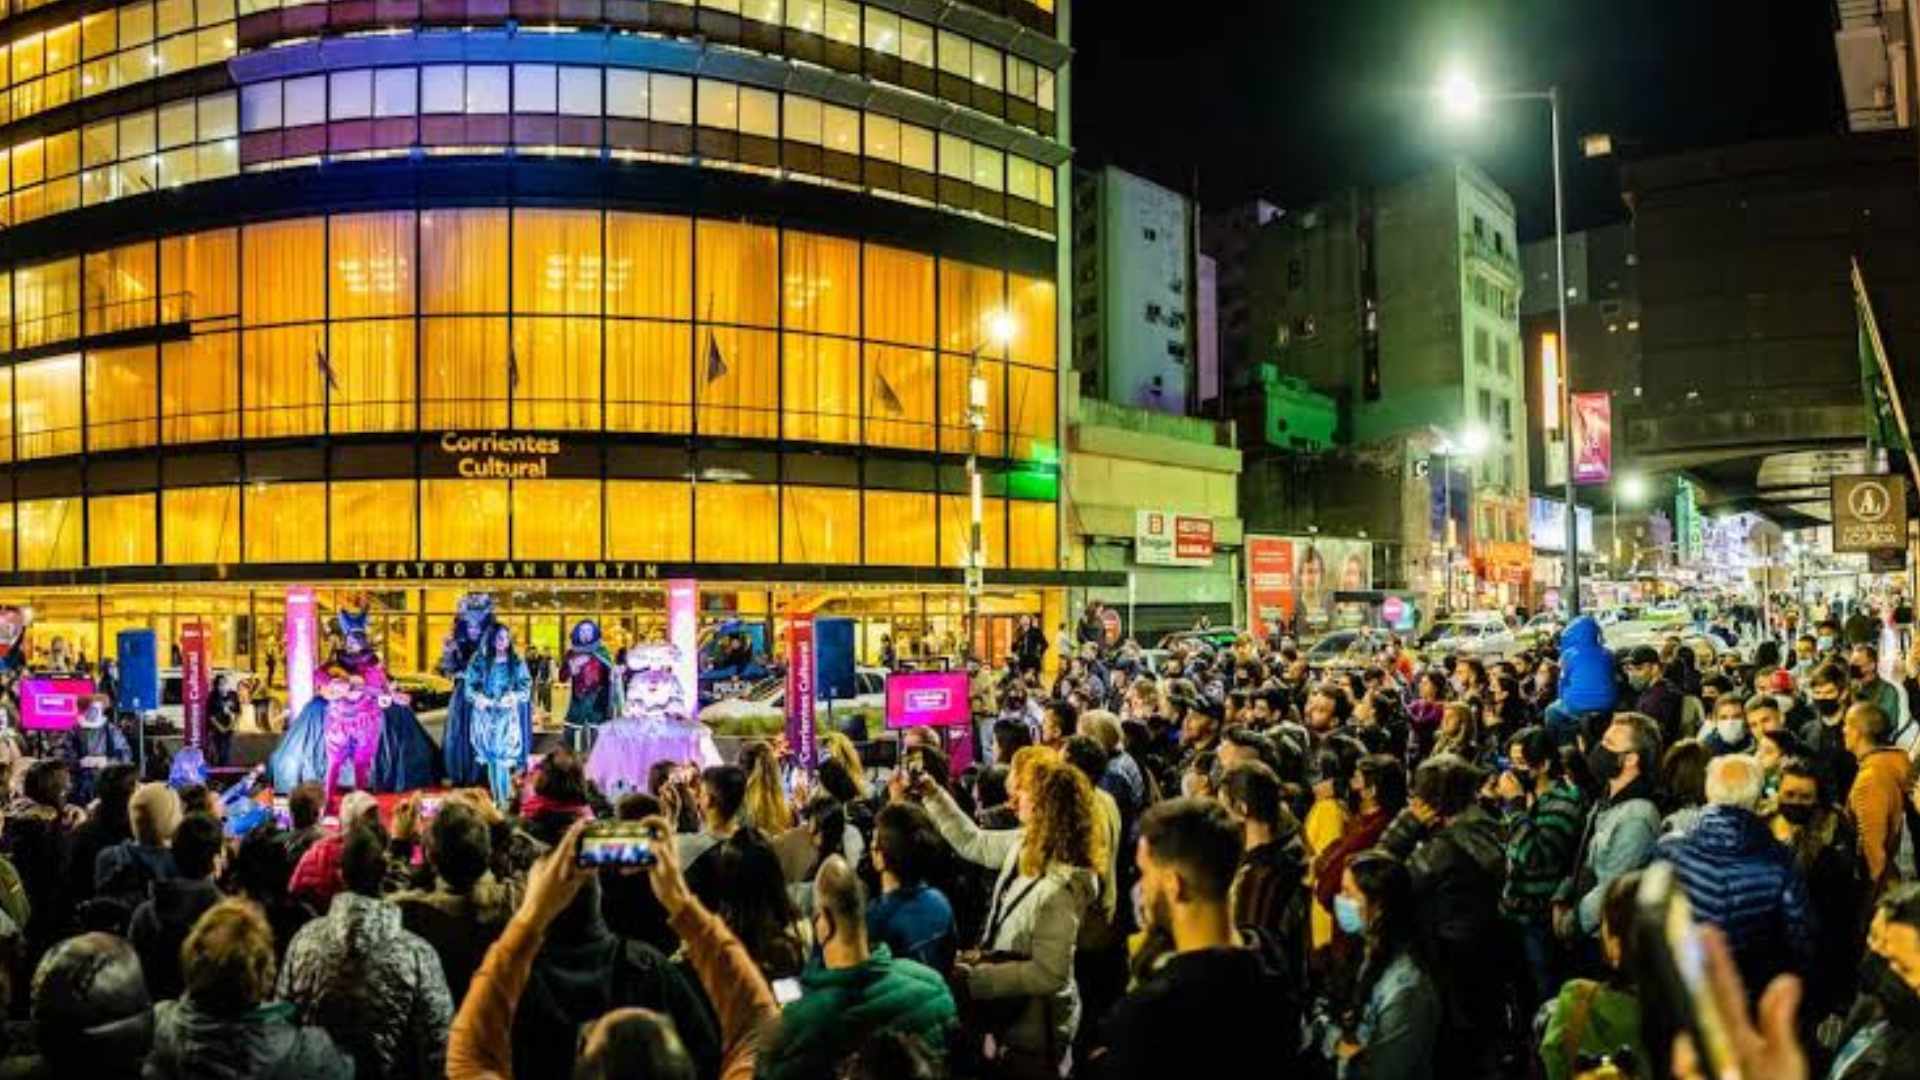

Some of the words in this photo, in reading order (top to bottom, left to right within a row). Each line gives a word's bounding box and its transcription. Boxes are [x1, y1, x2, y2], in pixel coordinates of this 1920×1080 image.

[441, 432, 559, 453] Corrientes
[458, 455, 547, 477] Cultural
[358, 563, 466, 577] TEATRO
[483, 563, 536, 577] SAN
[553, 562, 657, 578] MARTIN
[189, 651, 199, 699] Cultural
[799, 640, 810, 692] Cultural
[799, 693, 811, 762] Corrientes
